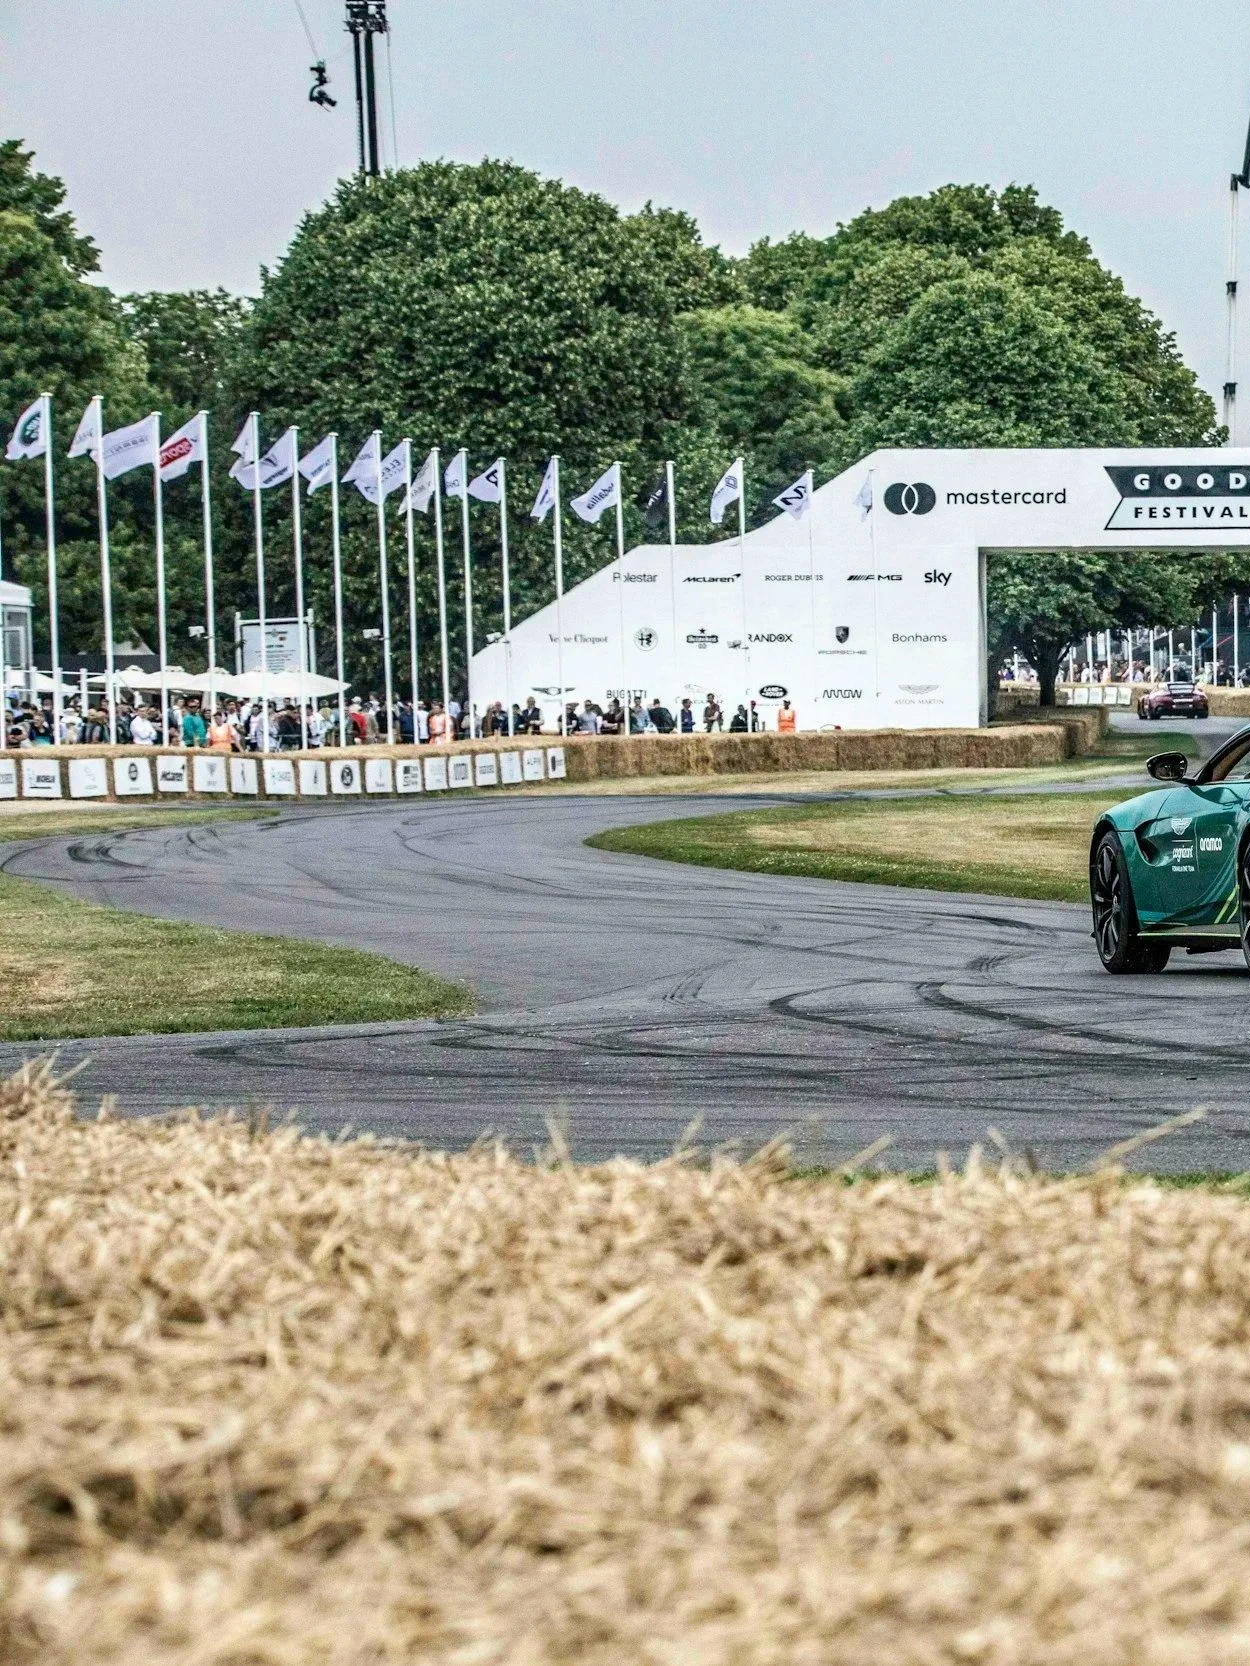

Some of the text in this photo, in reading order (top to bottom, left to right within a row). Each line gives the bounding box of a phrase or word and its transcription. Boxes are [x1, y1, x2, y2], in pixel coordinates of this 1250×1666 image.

[1133, 472, 1248, 491] GOOD
[947, 488, 1066, 505] mastercard
[1134, 505, 1249, 519] FESTIVAL
[765, 574, 792, 582] ROGER
[924, 569, 952, 586] sky
[891, 633, 948, 643] Bonhams
[1199, 837, 1223, 851] aramco
